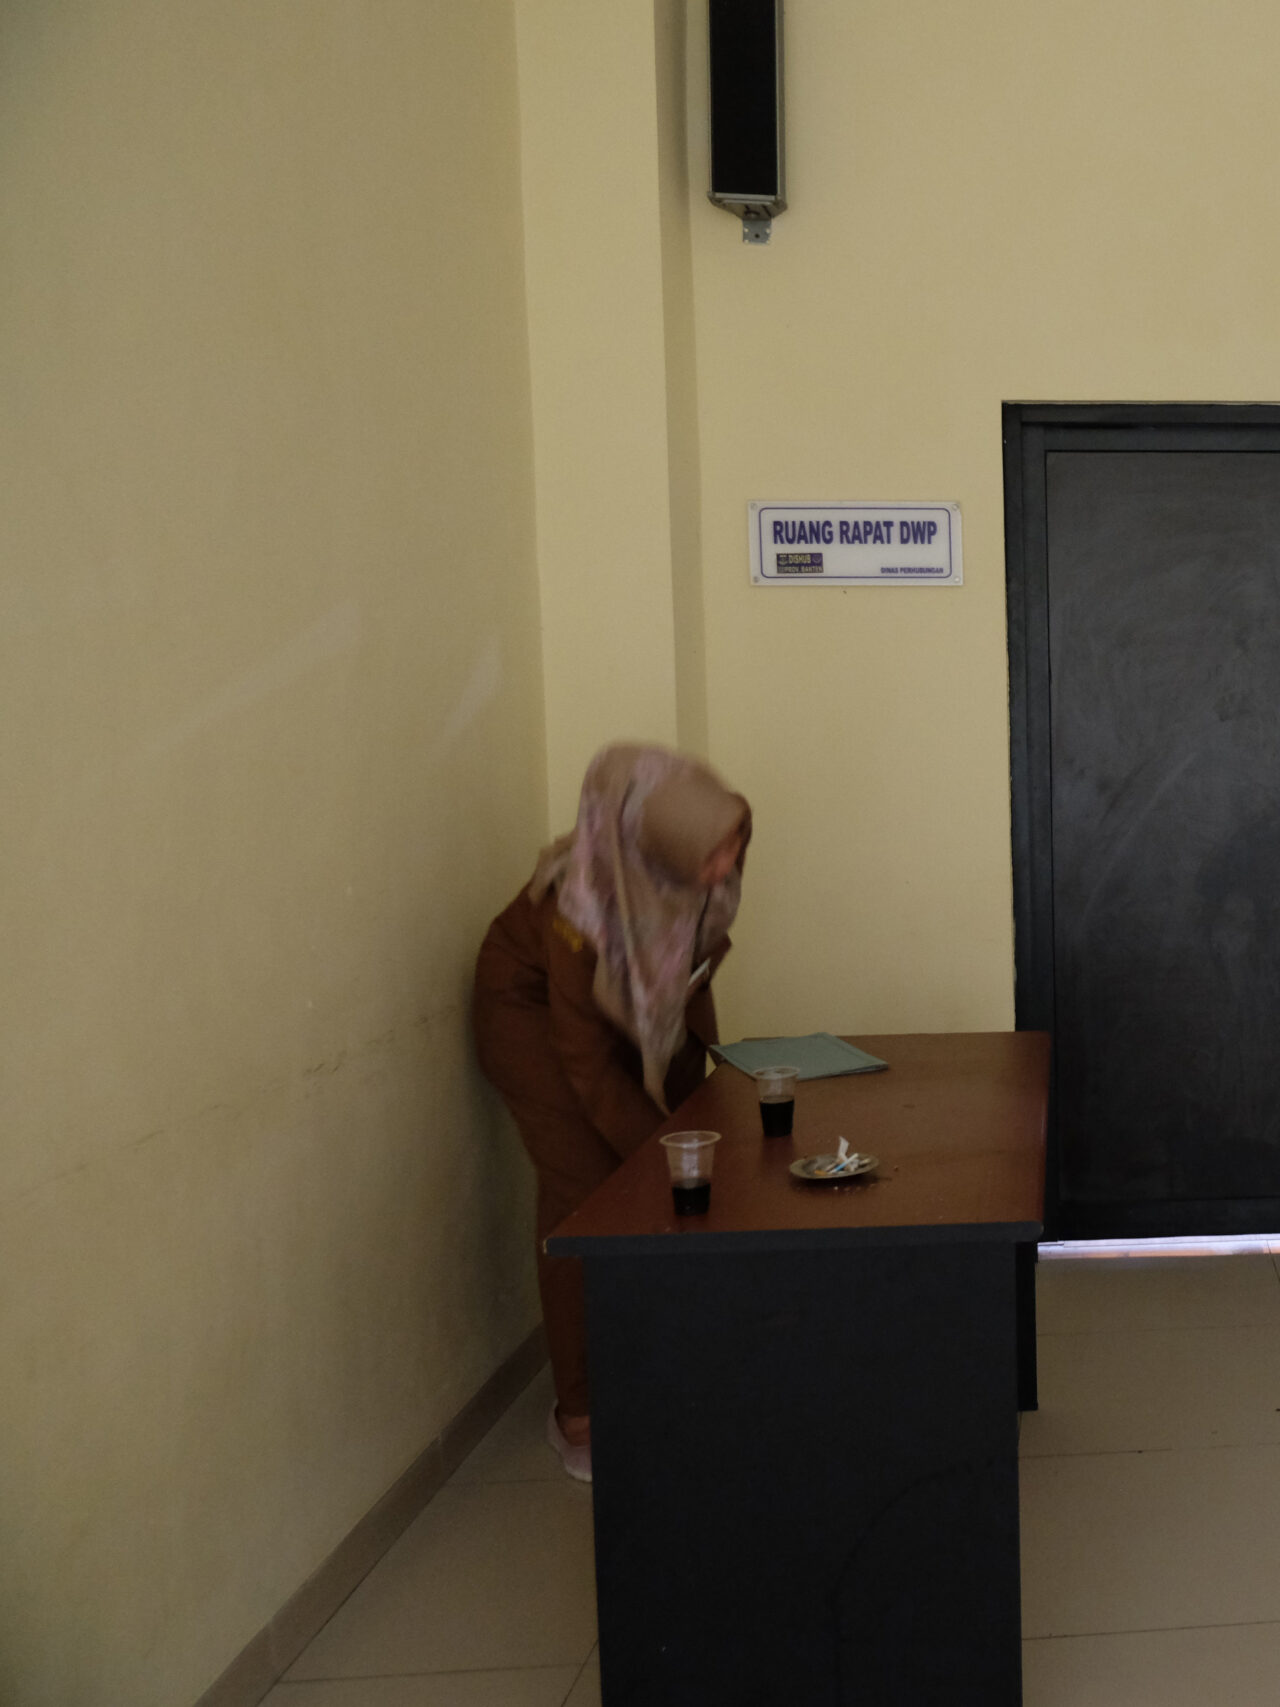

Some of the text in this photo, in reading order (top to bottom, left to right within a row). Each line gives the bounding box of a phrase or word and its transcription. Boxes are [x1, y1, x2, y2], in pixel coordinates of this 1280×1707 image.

[773, 520, 938, 545] RUANG RAPAT DWP
